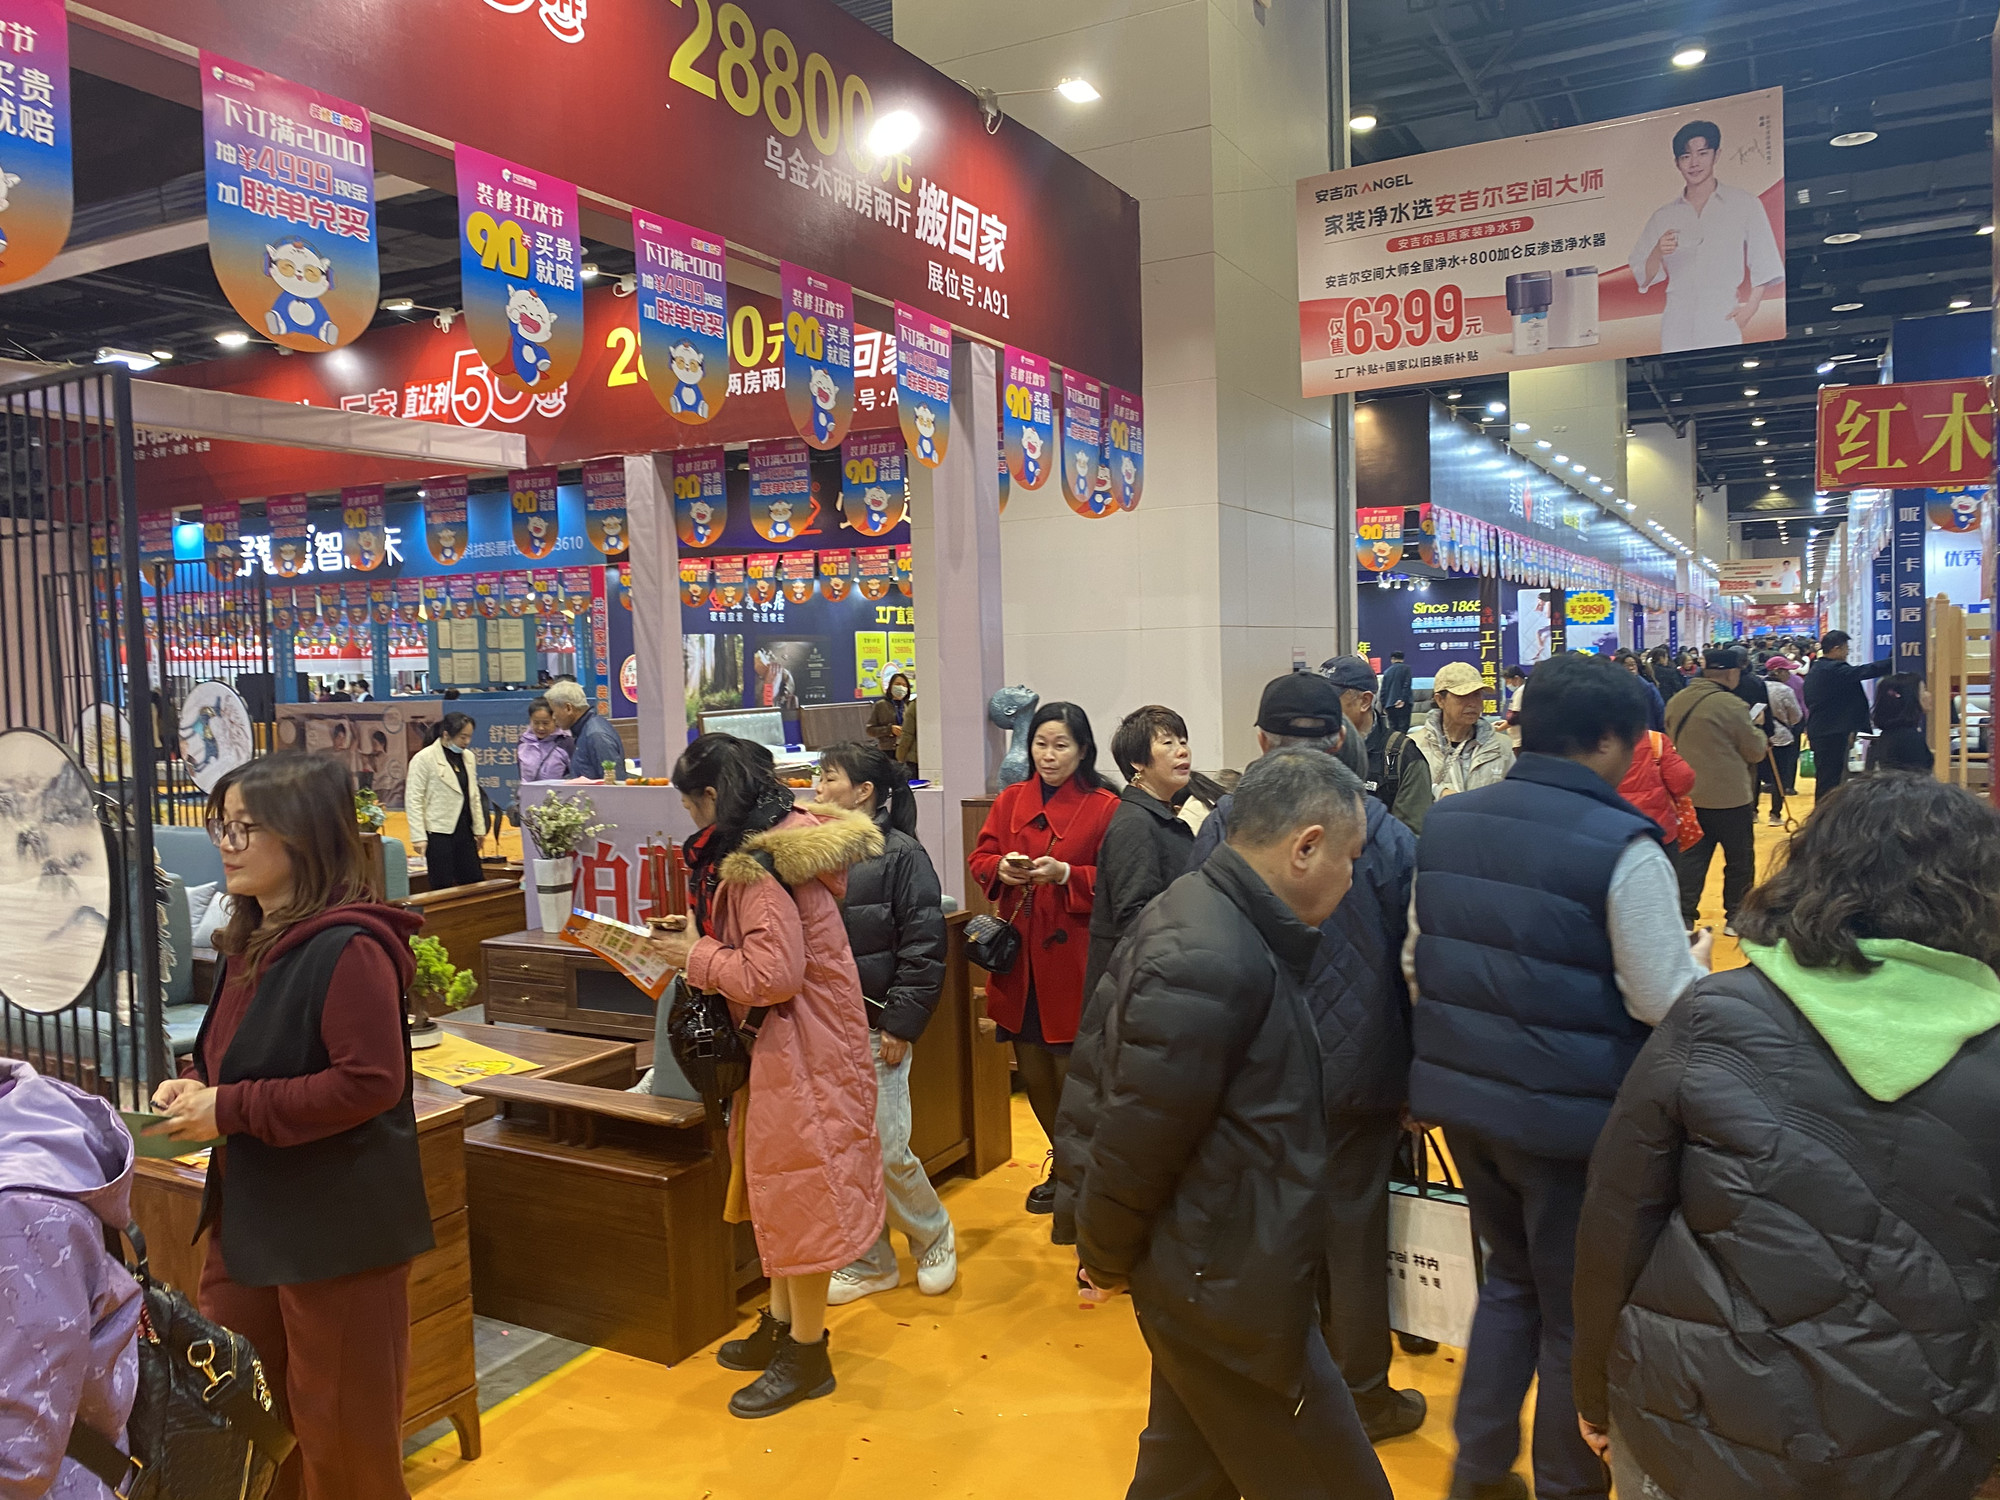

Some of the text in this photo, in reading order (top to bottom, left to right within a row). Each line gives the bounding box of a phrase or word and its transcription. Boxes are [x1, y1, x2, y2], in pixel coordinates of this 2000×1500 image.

[0, 21, 38, 53] 节
[215, 94, 365, 167] 下订满2000
[477, 181, 564, 228] 装修狂欢节
[764, 135, 1007, 273] 乌金木两房两厅 搬回家
[1315, 184, 1358, 203] 安吉尔
[1324, 168, 1604, 236] 家装净水选安吉尔空间大师
[536, 231, 574, 264] 买贵
[1397, 219, 1522, 250] 安吉尔品质家装净水节
[536, 258, 575, 291] 就赔
[641, 238, 722, 282] 下订满2000
[1325, 233, 1606, 288] 安吉尔空间大师全屋净水+800加仑反渗透净水器
[792, 289, 845, 320] 装修狂欢节
[927, 260, 1010, 319] 展位号:A91
[827, 323, 850, 347] 买贵
[827, 345, 850, 368] 就赔
[1334, 351, 1479, 379] 工厂补贴+国家以旧换新补贴
[727, 367, 785, 397] 两房两
[402, 380, 450, 418] 直让利
[853, 387, 899, 412] 号:A
[1834, 392, 1992, 475] 红木
[1412, 602, 1449, 614] Since
